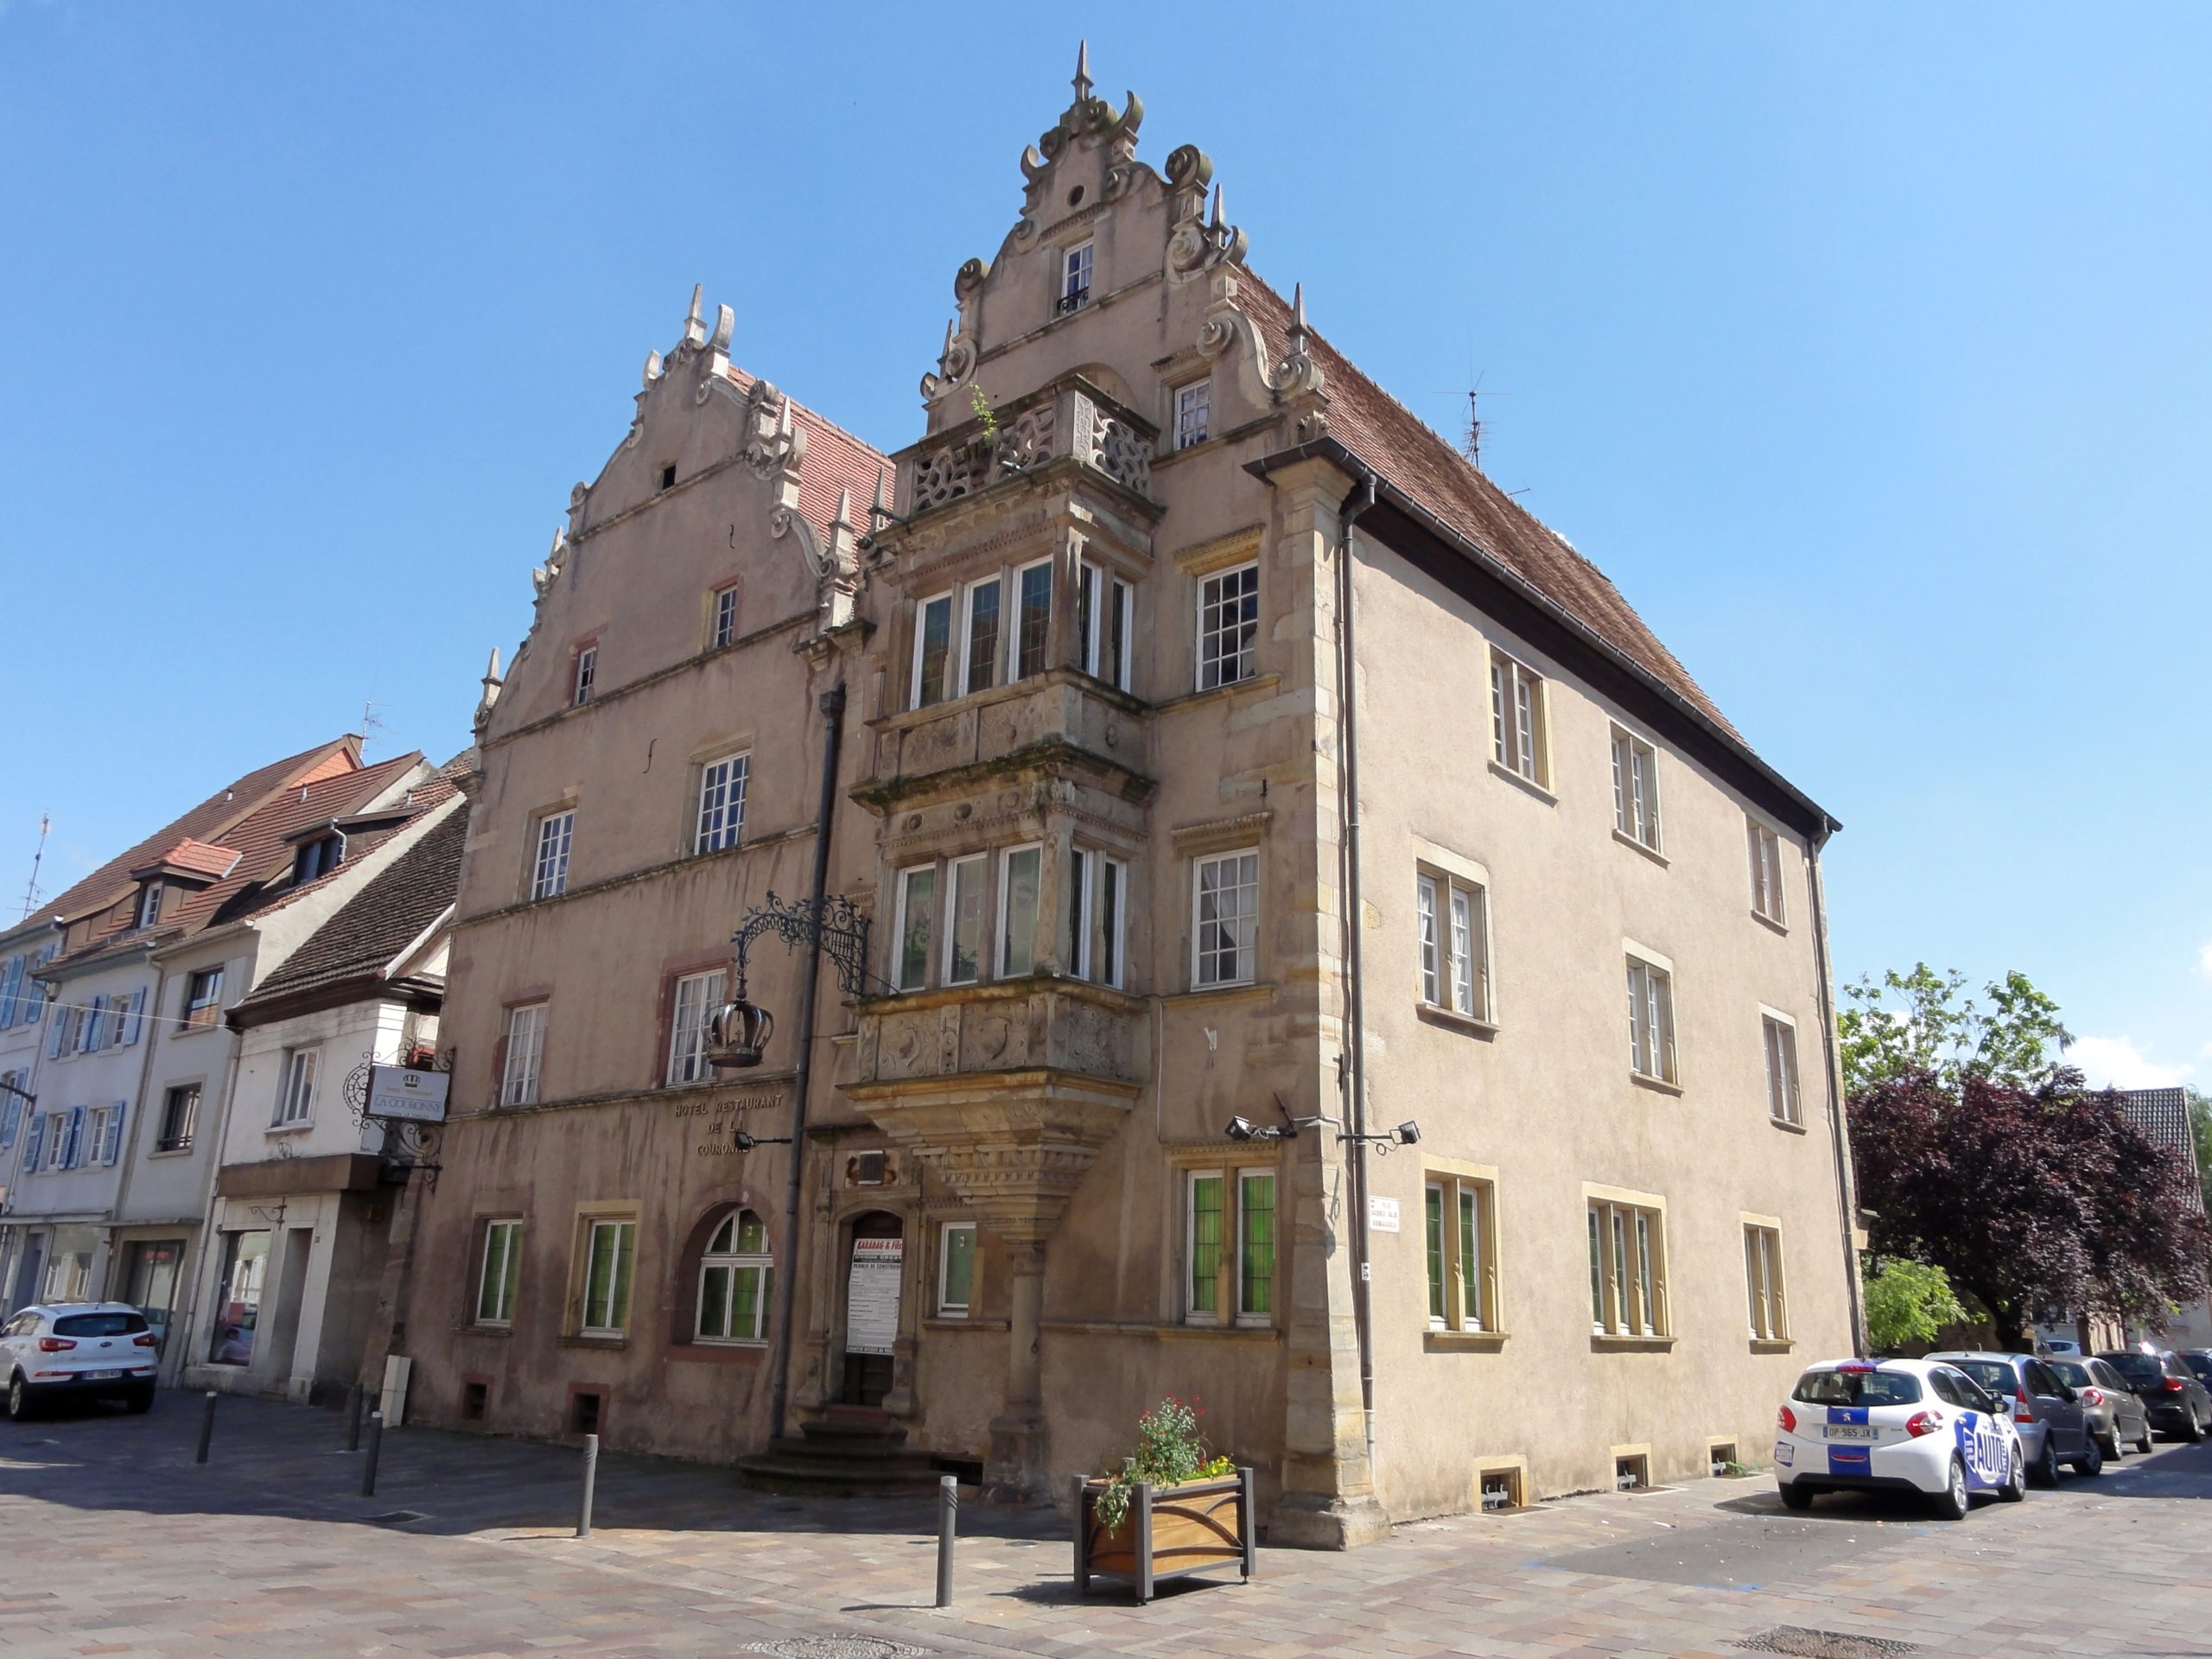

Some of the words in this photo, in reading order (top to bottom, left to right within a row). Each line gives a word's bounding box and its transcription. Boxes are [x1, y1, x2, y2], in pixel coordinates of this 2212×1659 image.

[374, 1096, 387, 1107] LA
[389, 1098, 442, 1112] COURONNE
[676, 1103, 709, 1117] HOTEL
[716, 1094, 784, 1114] RESTAURANT
[708, 1122, 722, 1134] DE
[697, 1141, 750, 1156] COURON
[1975, 1431, 2004, 1474] AUTO
